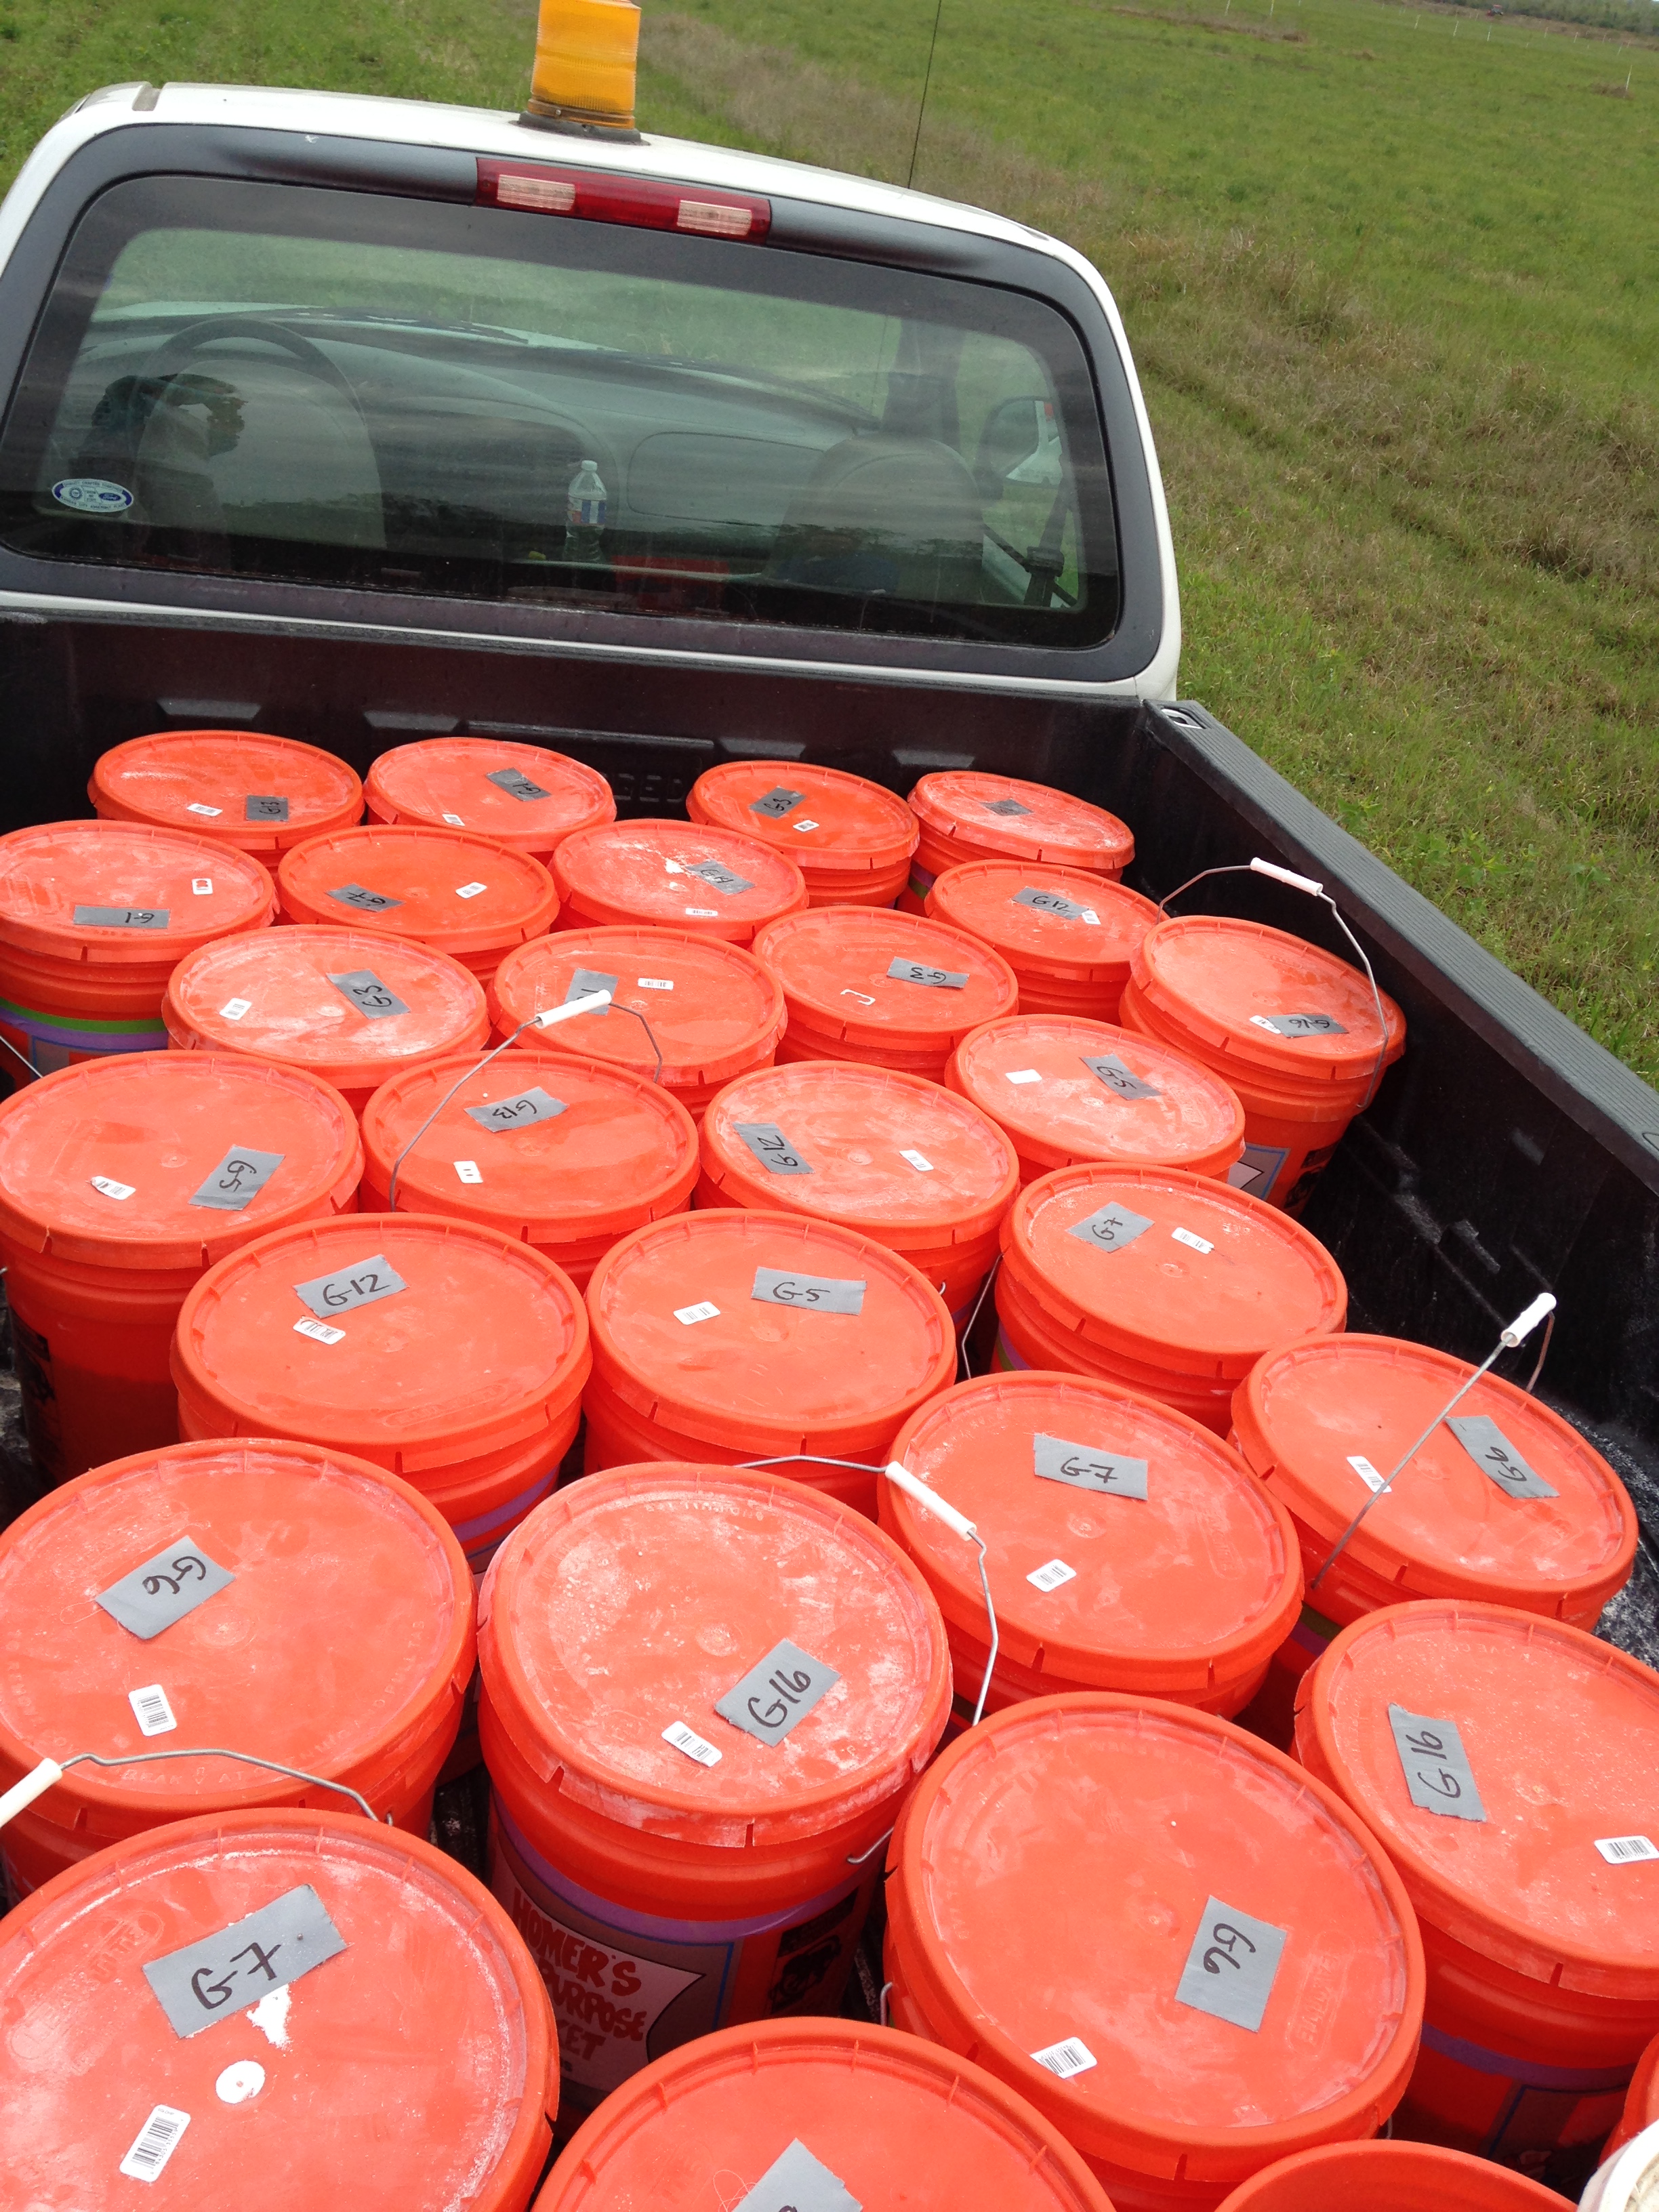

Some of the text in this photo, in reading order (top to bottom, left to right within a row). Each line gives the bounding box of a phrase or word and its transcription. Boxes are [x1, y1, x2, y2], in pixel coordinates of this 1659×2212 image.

[747, 1669, 811, 1728] G16
[1405, 1730, 1462, 1799] G16
[512, 1887, 642, 1996] HOMER'S
